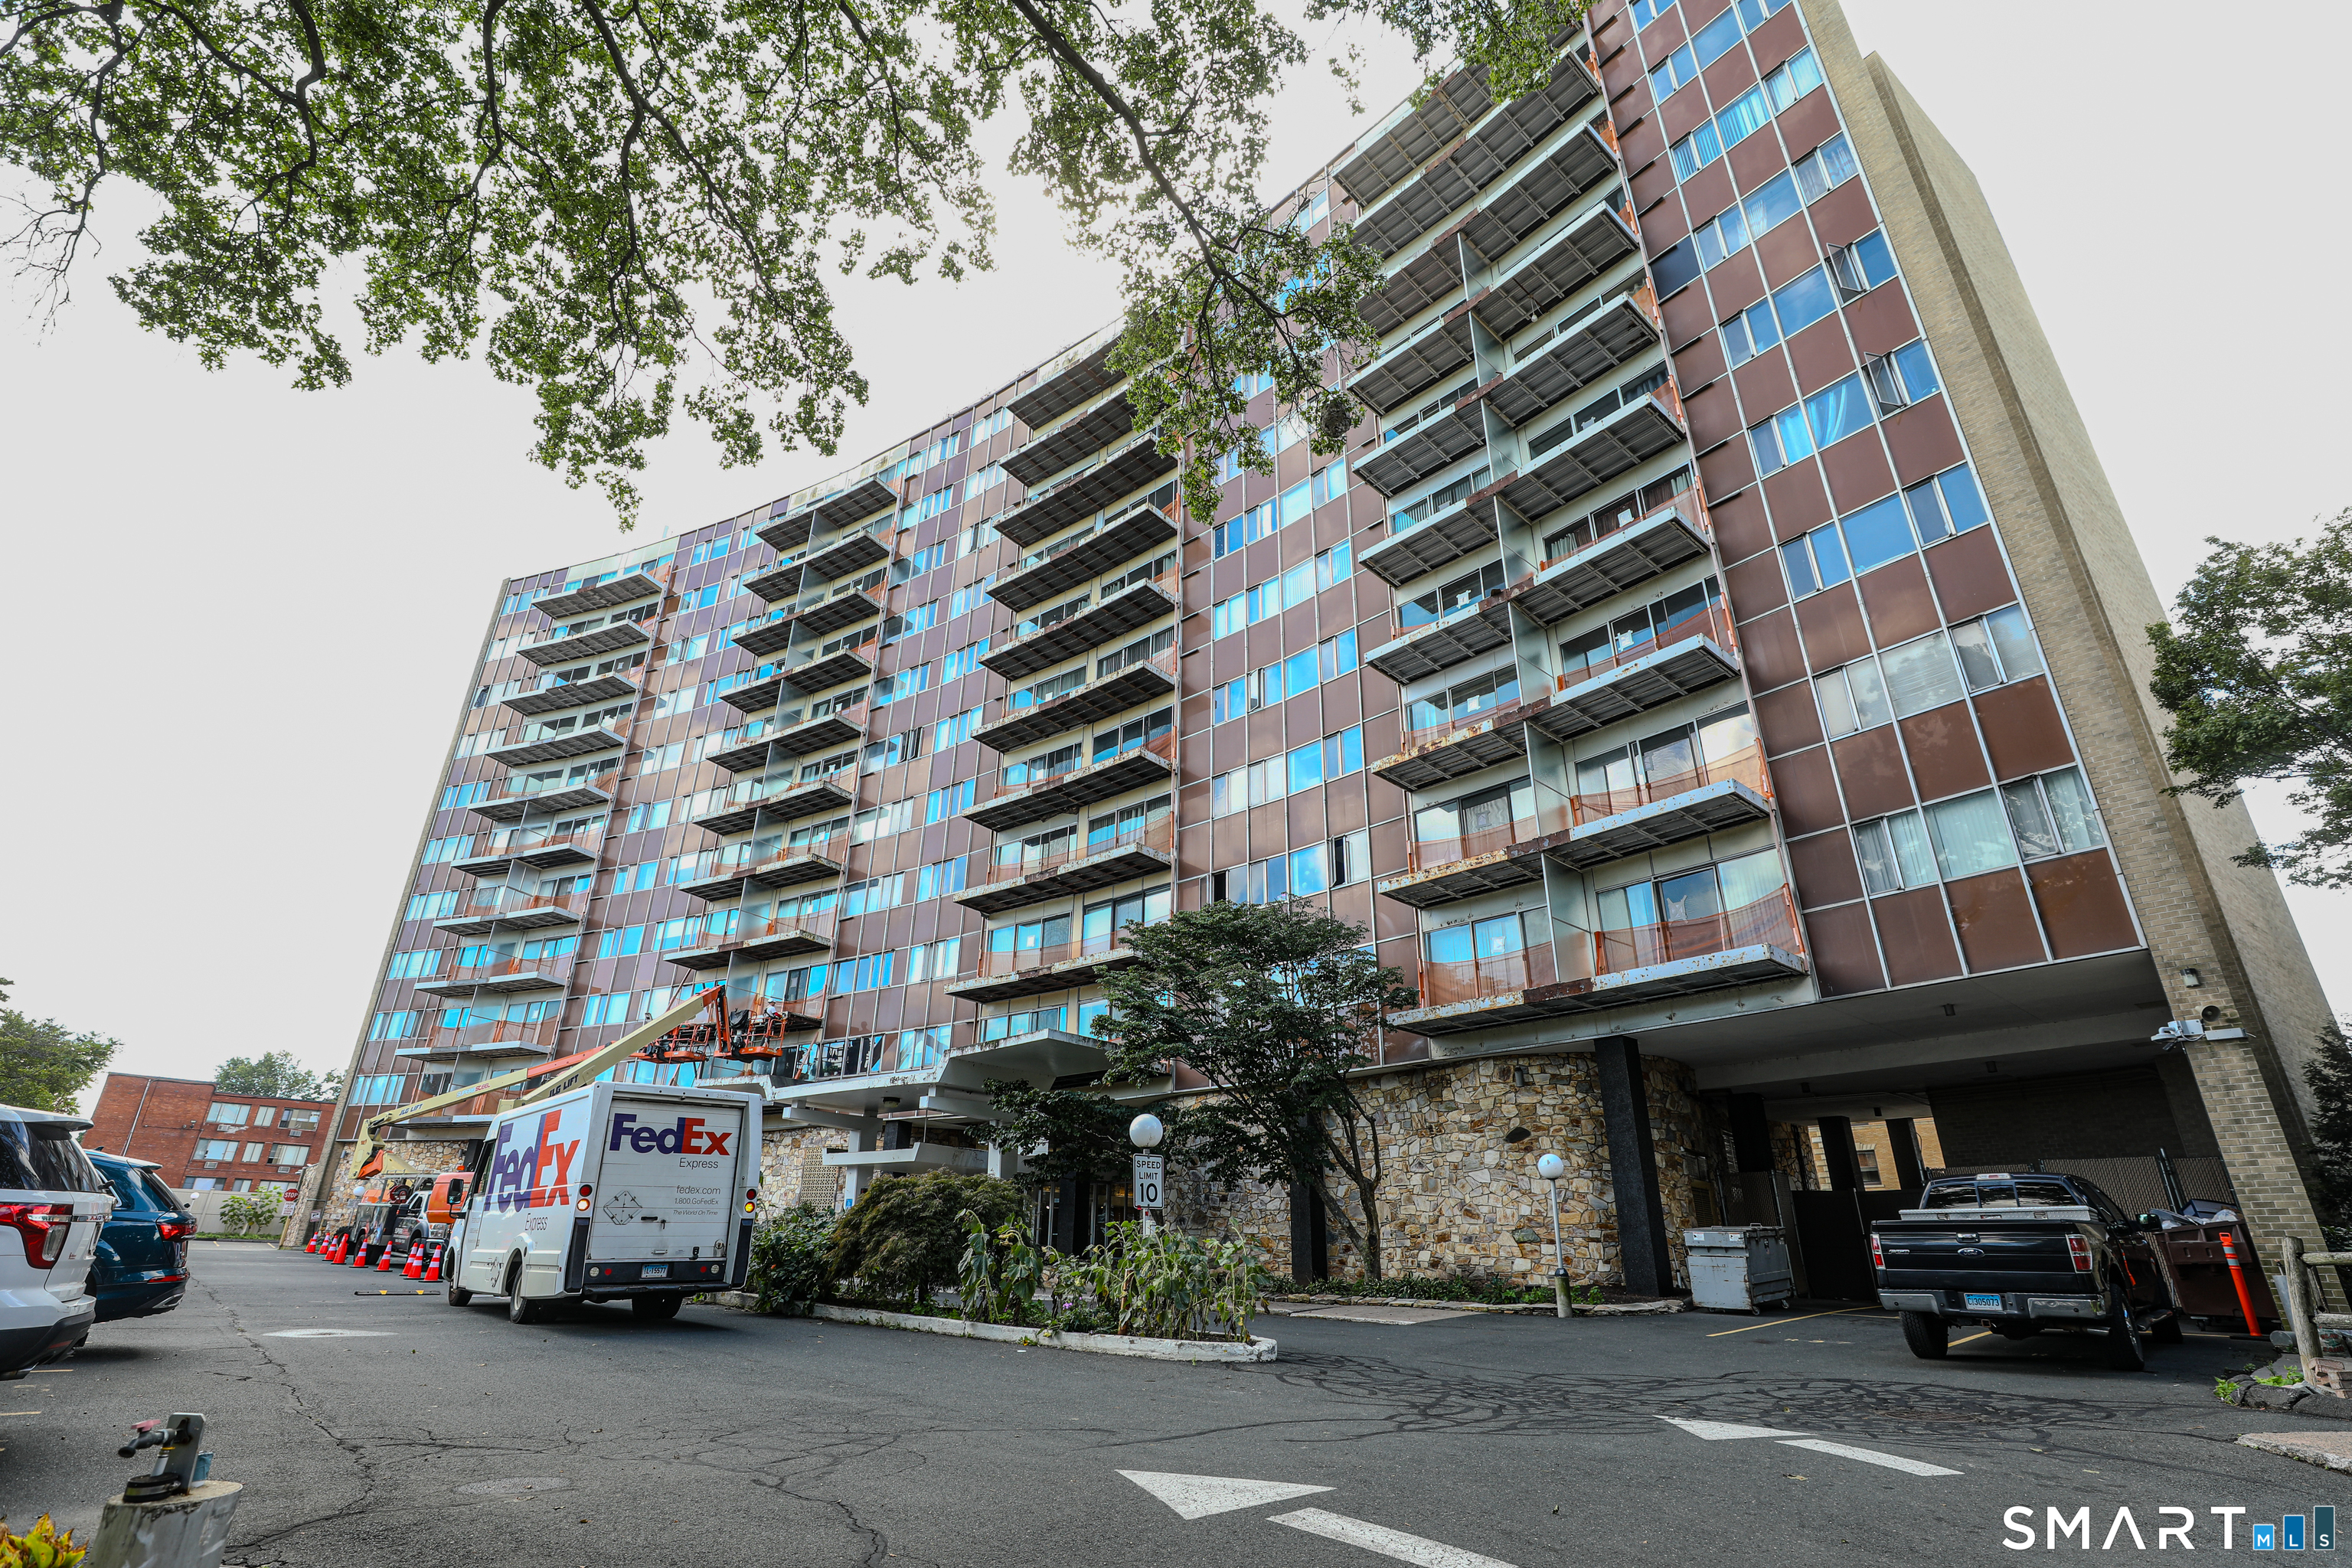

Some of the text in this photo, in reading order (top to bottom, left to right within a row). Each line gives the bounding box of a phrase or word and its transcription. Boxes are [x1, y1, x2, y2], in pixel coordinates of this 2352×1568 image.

[549, 1073, 580, 1098] JLG LIFT
[410, 1103, 423, 1112] LIFT
[609, 1113, 733, 1156] FedEx
[484, 1109, 581, 1214] FedEx
[679, 1157, 719, 1170] Express
[1136, 1160, 1161, 1169] SPEED
[1138, 1171, 1158, 1180] LIMIT
[676, 1184, 721, 1194] fedex.com
[1139, 1182, 1158, 1203] 10
[524, 1213, 548, 1234] Express
